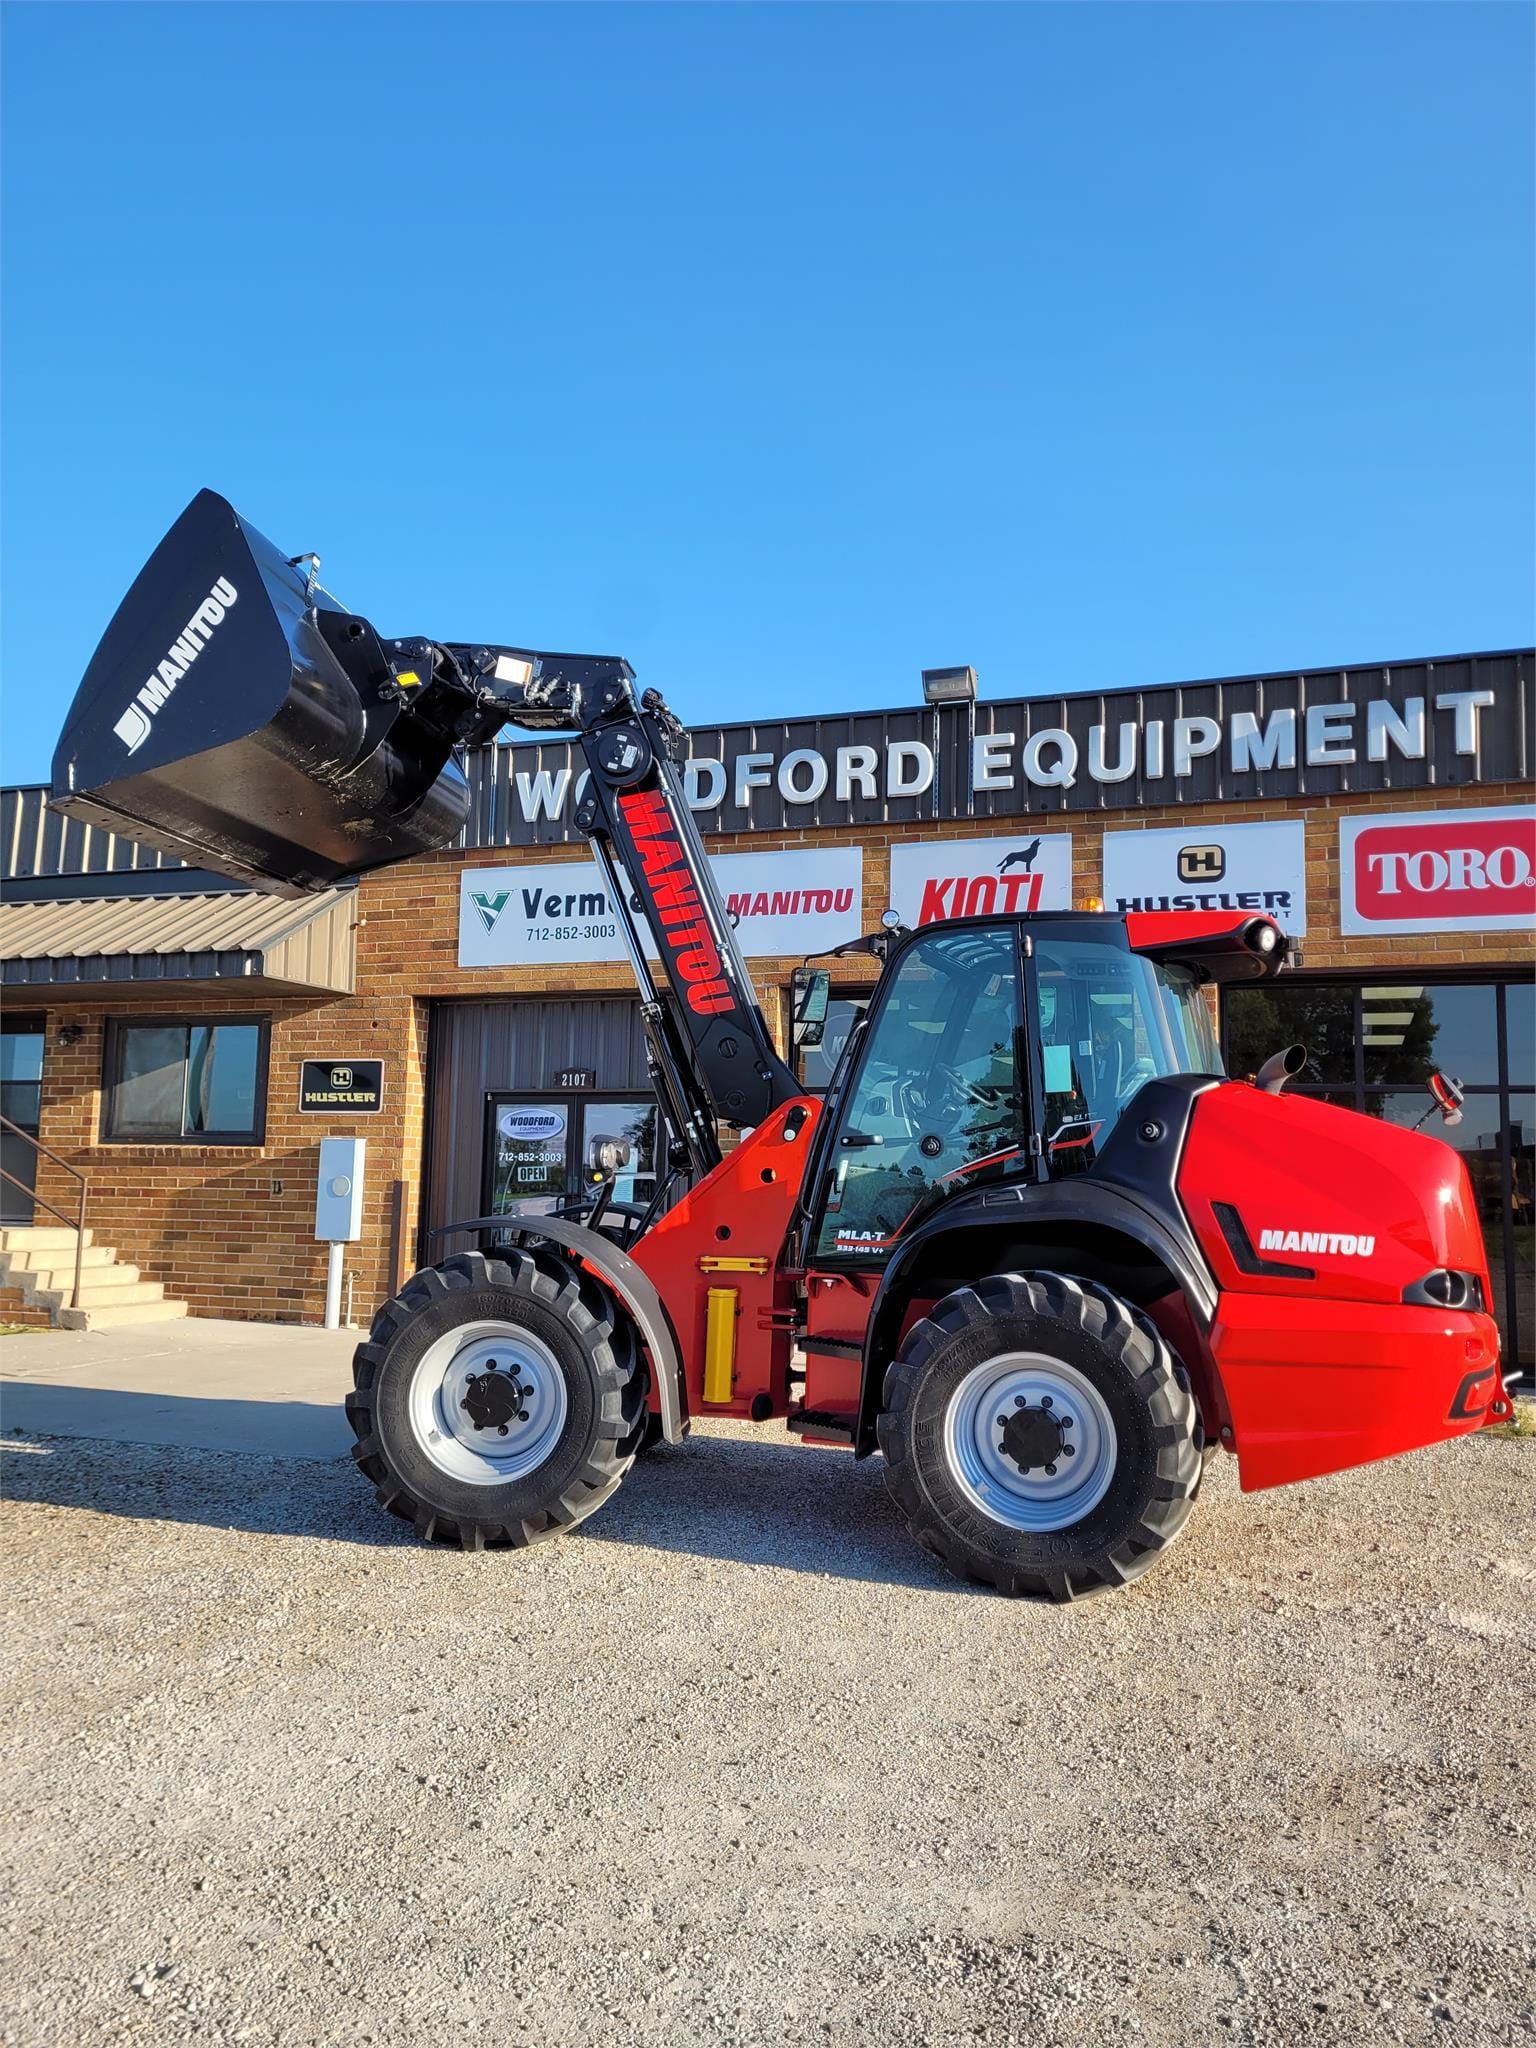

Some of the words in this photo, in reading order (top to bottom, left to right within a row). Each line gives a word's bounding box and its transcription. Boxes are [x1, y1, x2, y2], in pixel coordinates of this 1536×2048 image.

[136, 575, 238, 715] MANITOU
[515, 741, 934, 822] WDFORD
[973, 690, 1494, 791] EQUIPMENT
[618, 789, 736, 1015] MANITOU
[726, 888, 854, 917] MANITOU
[918, 873, 1044, 928] KIOTI
[1116, 890, 1291, 912] HUSTLER
[526, 924, 616, 941] 712-852-3003
[561, 1073, 586, 1087] 2107
[305, 1092, 376, 1102] HUSTLER
[510, 1116, 555, 1126] WOODFORD
[498, 1152, 562, 1162] 712-852-3003
[520, 1167, 546, 1180] OPEN
[1259, 1229, 1375, 1257] MANITOU
